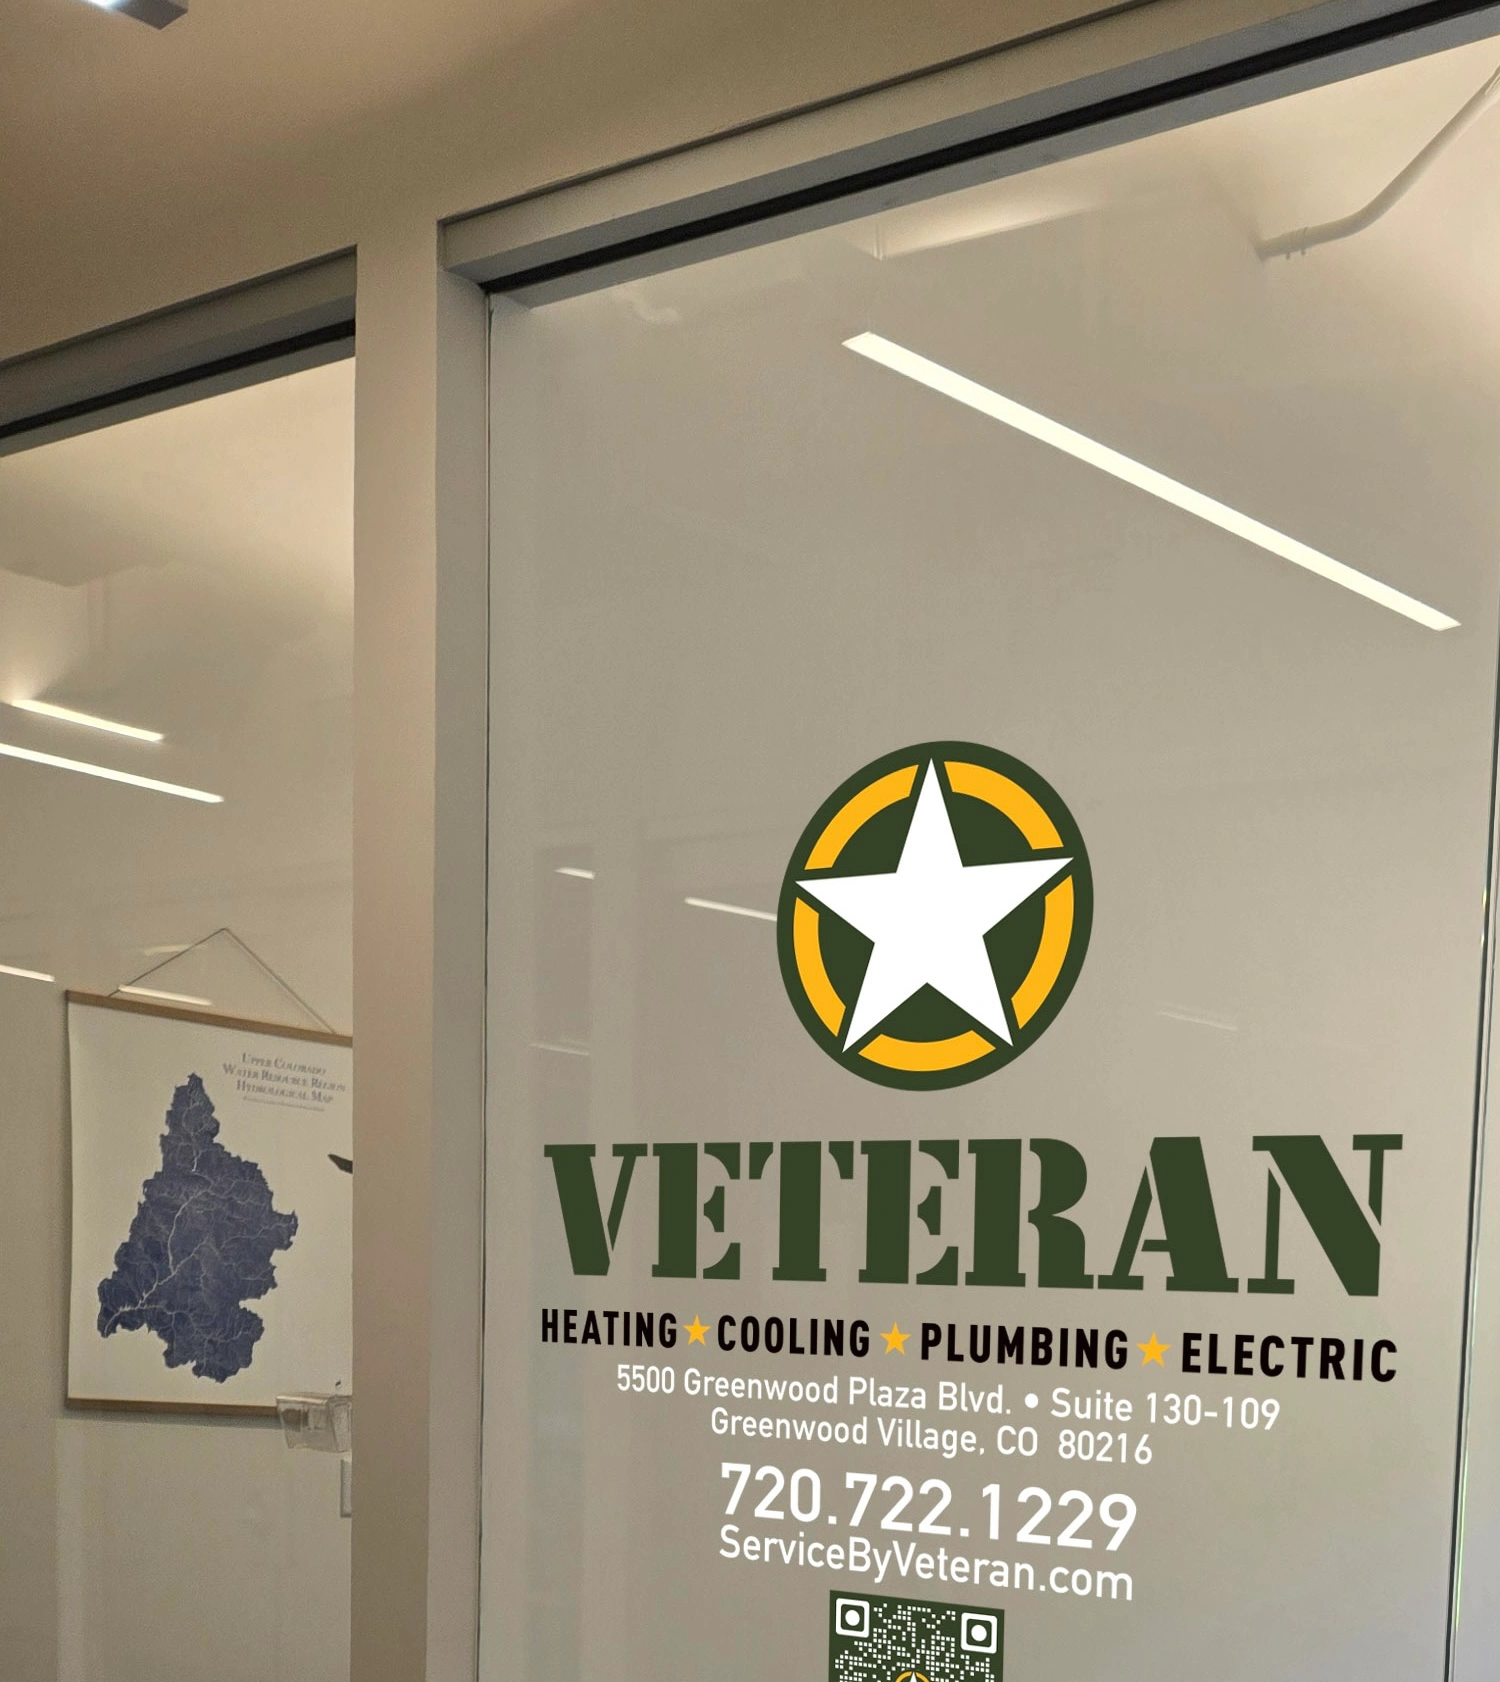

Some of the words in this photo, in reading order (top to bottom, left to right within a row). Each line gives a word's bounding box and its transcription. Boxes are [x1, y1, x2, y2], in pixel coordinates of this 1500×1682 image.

[543, 1133, 1403, 1297] VETERAN
[541, 1308, 678, 1349] HEATING
[717, 1314, 870, 1358] COOLING
[921, 1322, 1128, 1370] PLUMBING
[1181, 1332, 1398, 1383] ELECTRIC
[617, 1364, 675, 1394] 5500
[684, 1367, 838, 1404] Greenwood
[849, 1376, 926, 1410] Plaza
[938, 1381, 1013, 1414] Blvd.
[1050, 1387, 1133, 1423] Suite
[1146, 1392, 1281, 1431] 130-109
[711, 1406, 868, 1445] Greenwood
[876, 1417, 986, 1459] Village,
[997, 1425, 1038, 1457] CO
[1058, 1429, 1153, 1465] 80216
[721, 1462, 1138, 1551] 720.722.1229
[719, 1524, 1133, 1601] ServiceByVeteran.com
